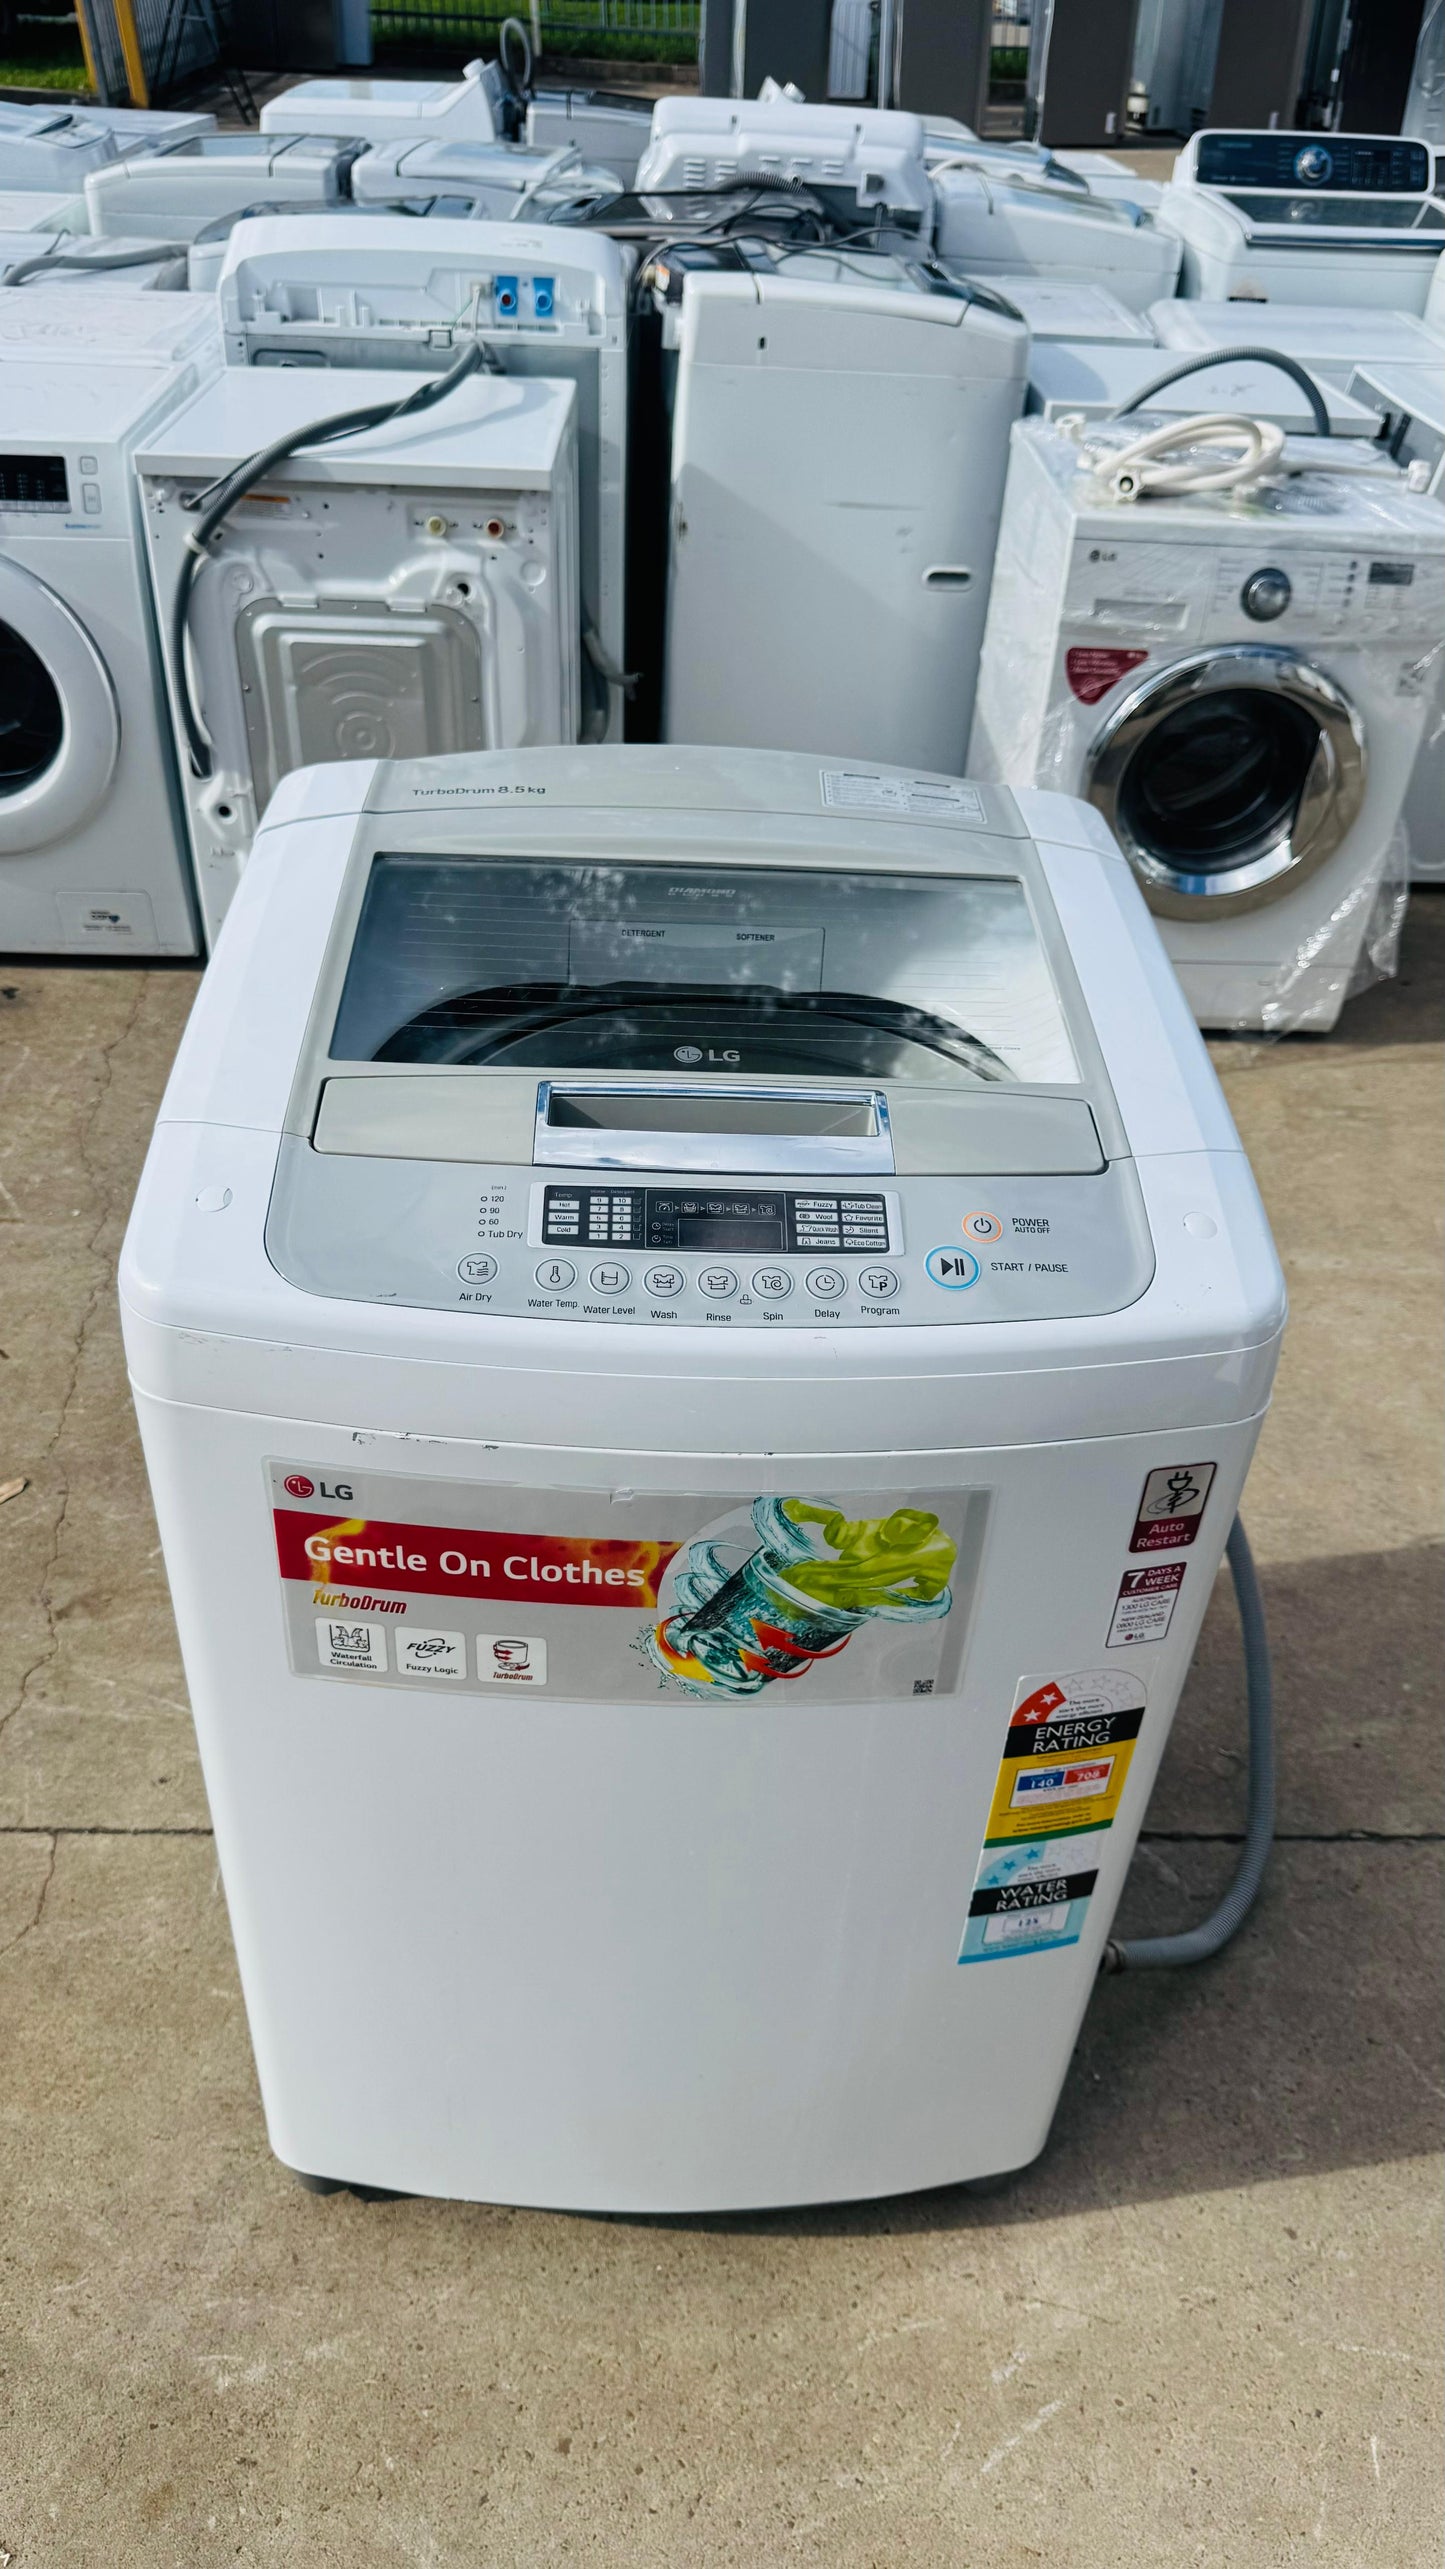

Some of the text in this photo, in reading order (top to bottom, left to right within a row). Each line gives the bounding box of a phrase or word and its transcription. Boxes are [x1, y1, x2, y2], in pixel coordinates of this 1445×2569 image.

[413, 787, 495, 796] TurboDrum
[621, 930, 666, 938] DETERGENT
[736, 933, 775, 941] SOFTENER
[708, 1049, 741, 1062] LG
[1012, 1217, 1050, 1227] POWER
[488, 1230, 524, 1239] Tub Dry
[990, 1262, 1025, 1272] START
[1035, 1263, 1069, 1273] PAUSE
[458, 1293, 492, 1304] Air Dry
[527, 1299, 580, 1310] Water Temp.
[583, 1305, 636, 1316] Water Level
[650, 1310, 678, 1319] Wash
[763, 1311, 784, 1322] Spin
[814, 1309, 841, 1320] Delay
[860, 1305, 900, 1317] Program
[706, 1313, 732, 1322] Rinse
[320, 1481, 354, 1501] LG
[1149, 1522, 1185, 1535] Auto
[1136, 1533, 1191, 1549] Restart
[304, 1535, 645, 1588] Gentle On Clothes
[1127, 1571, 1146, 1589] 7
[1147, 1566, 1172, 1577] DAYS
[1145, 1573, 1180, 1586] WEEK
[1122, 1582, 1178, 1596] CUSTOMER CARE
[313, 1589, 407, 1614] TurboDrum
[406, 1642, 456, 1654] FUZZY
[331, 1651, 372, 1662] Waterfall
[330, 1659, 377, 1670] Circulation
[406, 1663, 459, 1675] Fuzzy Logic
[493, 1671, 533, 1681] TurboDrum
[1035, 1716, 1116, 1740] ENERGY
[1032, 1731, 1111, 1754] RATING
[1031, 1777, 1054, 1789] 140
[1000, 1878, 1068, 1900] WATER
[995, 1889, 1068, 1912] RATING
